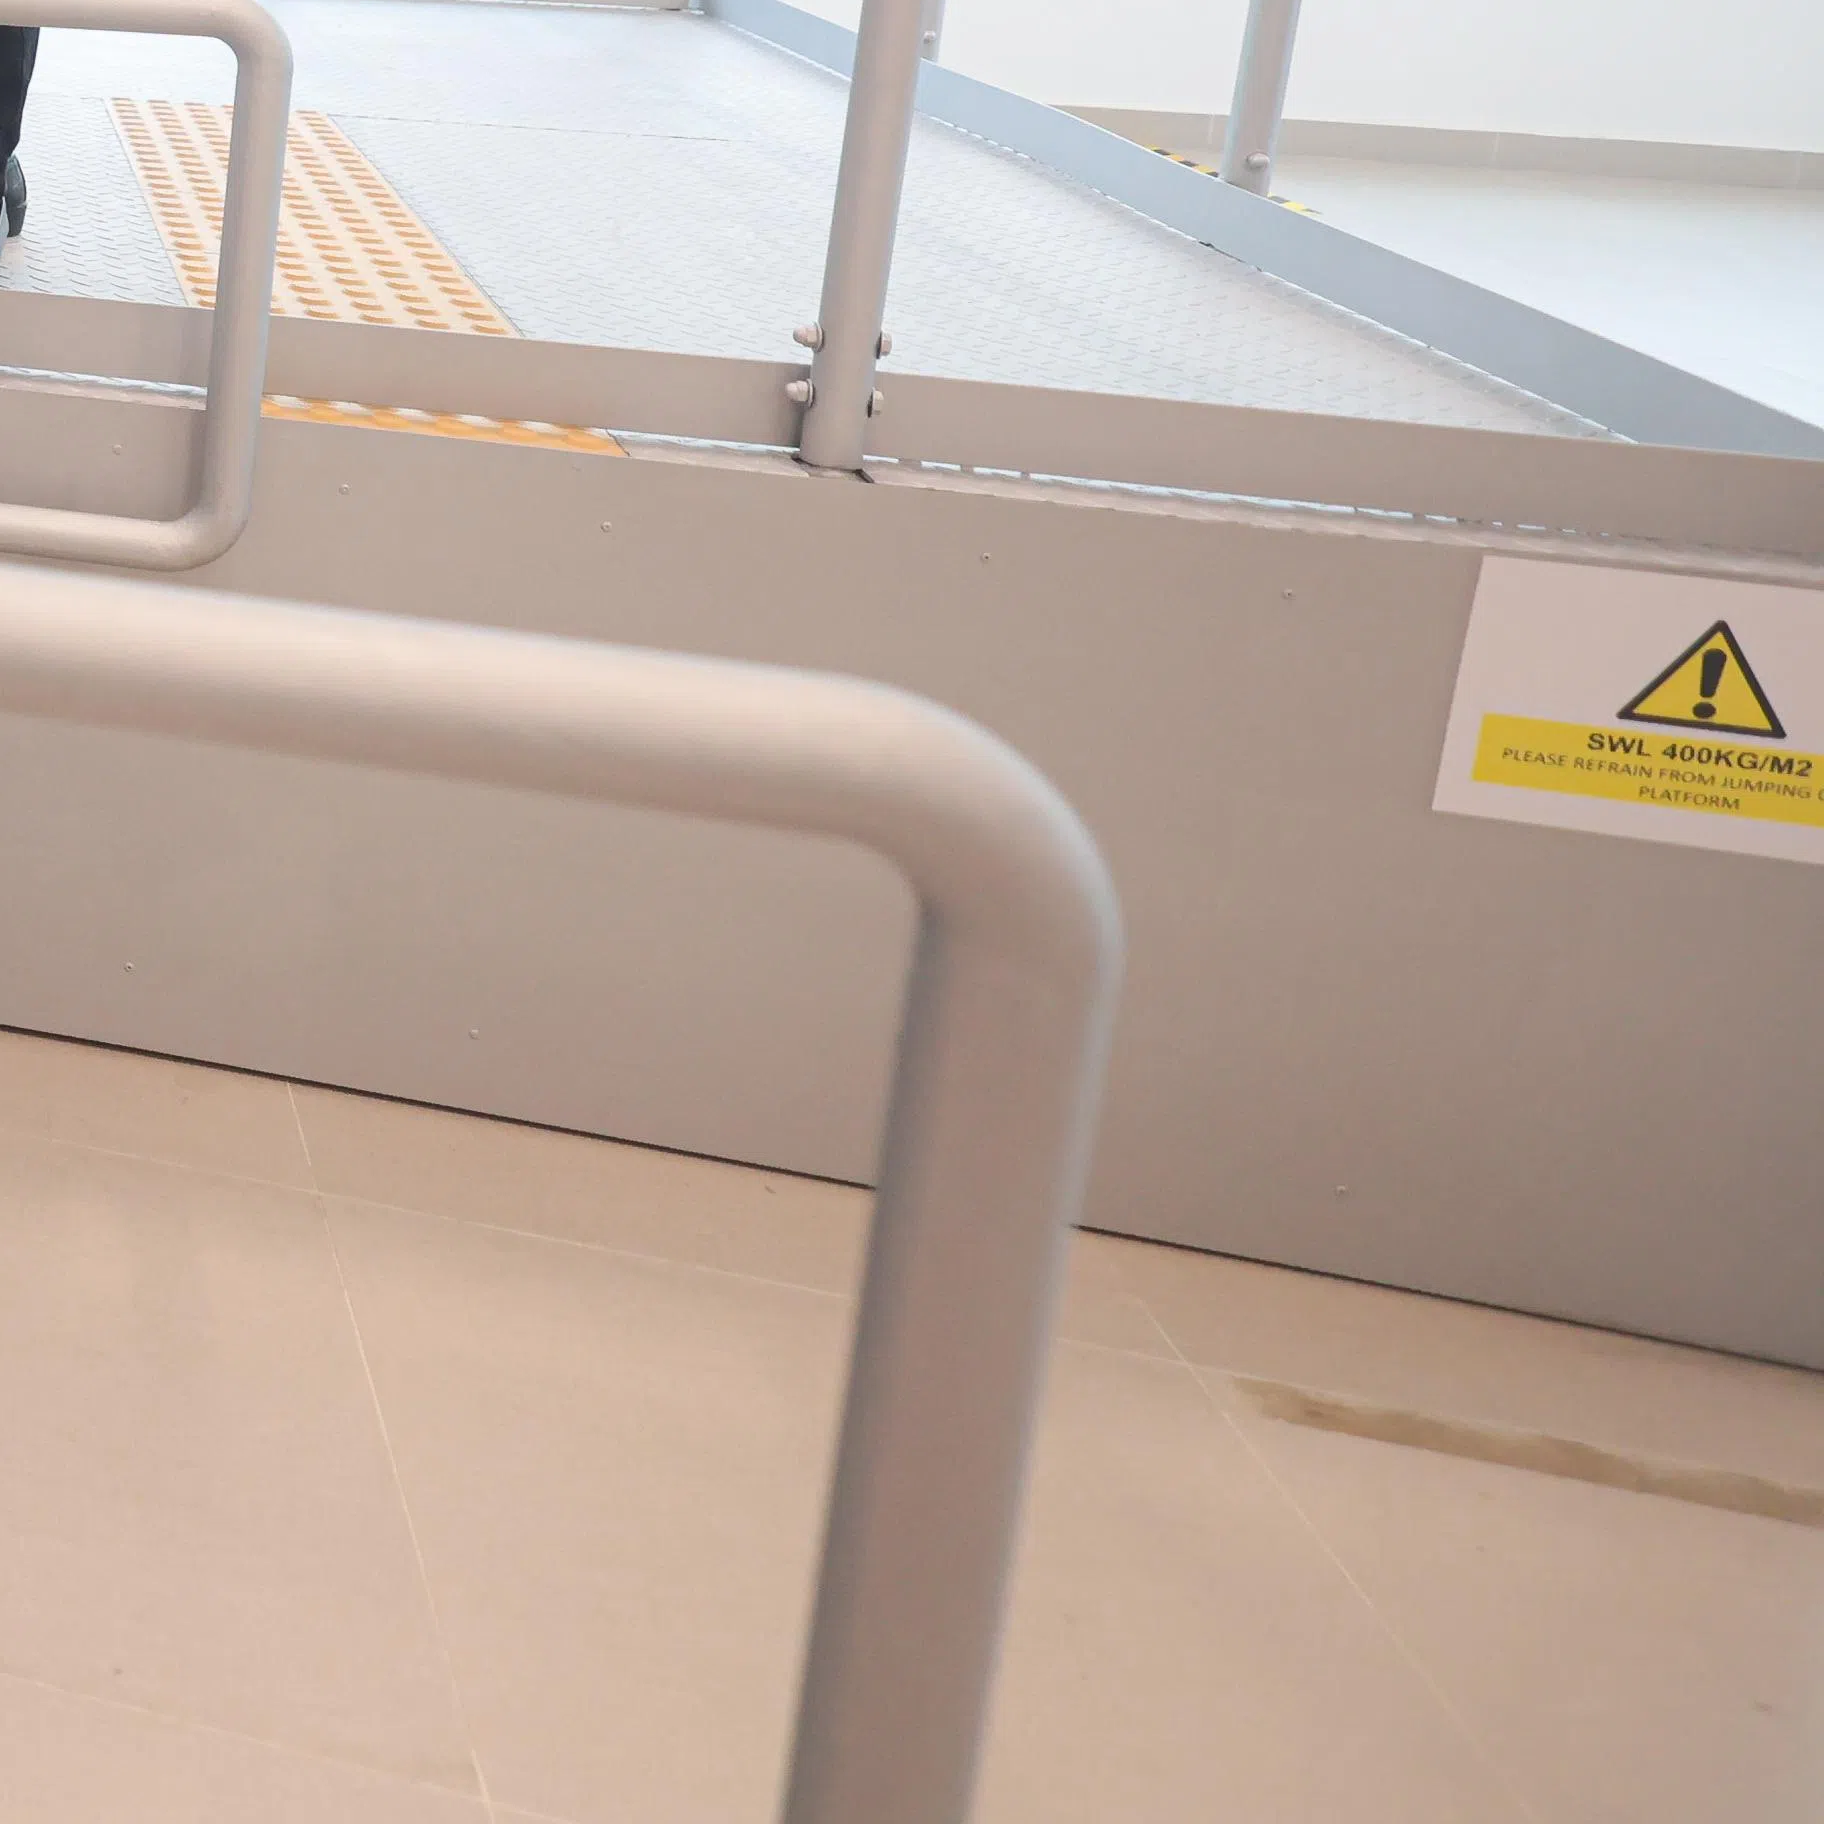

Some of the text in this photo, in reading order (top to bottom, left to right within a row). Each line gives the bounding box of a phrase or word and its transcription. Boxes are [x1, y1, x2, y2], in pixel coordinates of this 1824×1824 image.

[1502, 748, 1567, 766] PLEASE
[1574, 757, 1652, 777] REFRAIN
[1659, 768, 1715, 785] FROM
[1721, 777, 1811, 799] JUMPING
[1588, 733, 1812, 777] SWL 400KG/M2
[1639, 786, 1739, 809] PLATFORM
